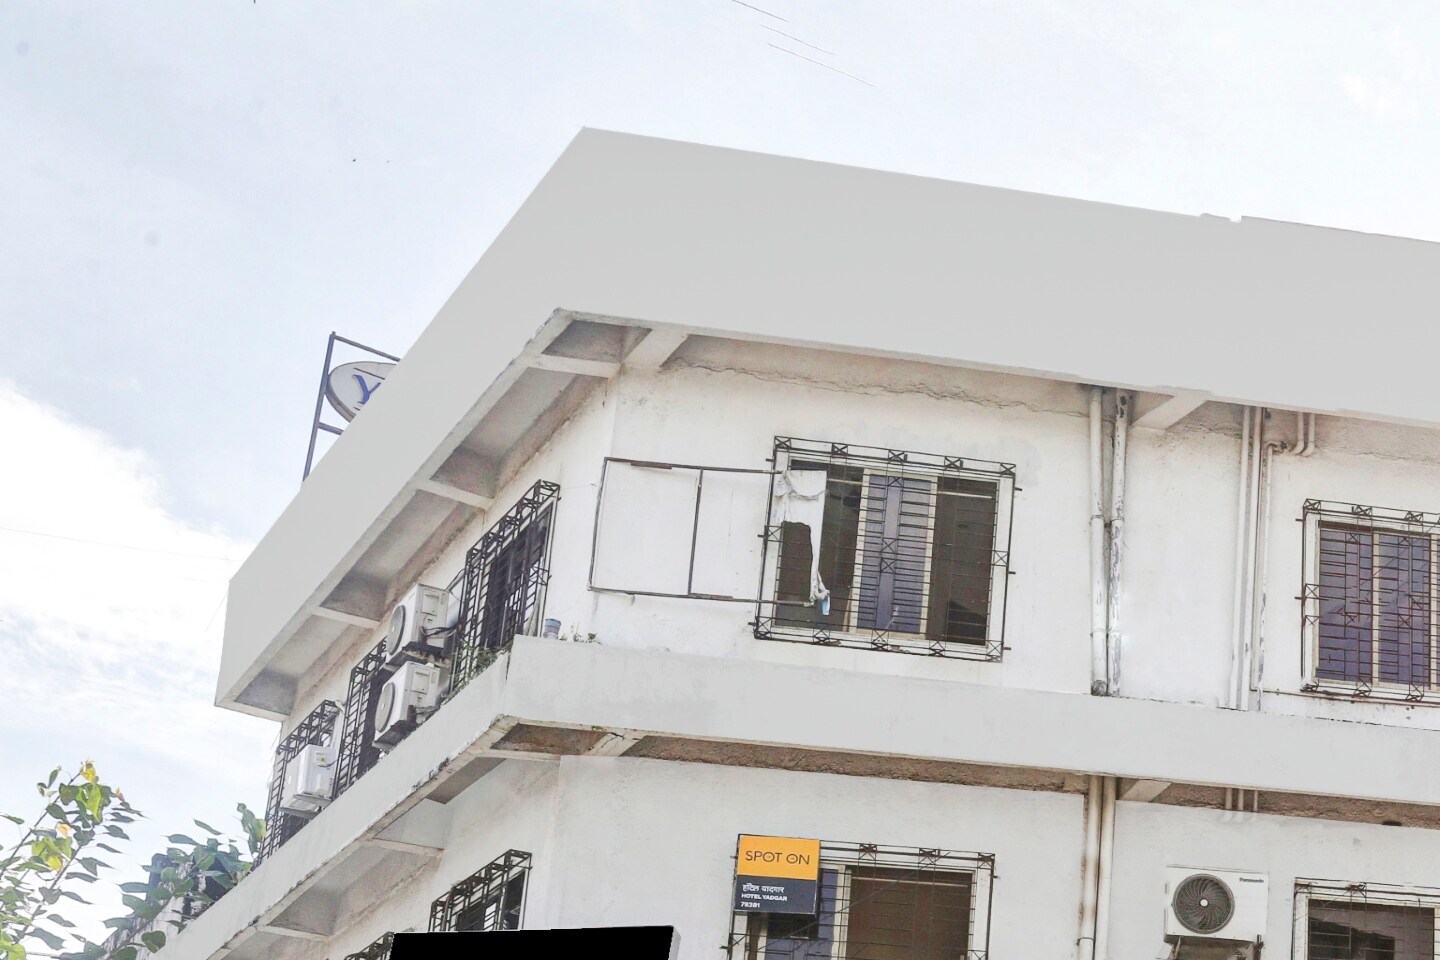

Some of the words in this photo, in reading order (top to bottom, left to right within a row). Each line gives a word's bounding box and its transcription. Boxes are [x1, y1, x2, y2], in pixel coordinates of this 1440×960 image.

[745, 850, 783, 863] SPOT
[786, 853, 811, 865] ON
[762, 894, 788, 902] YADGAR
